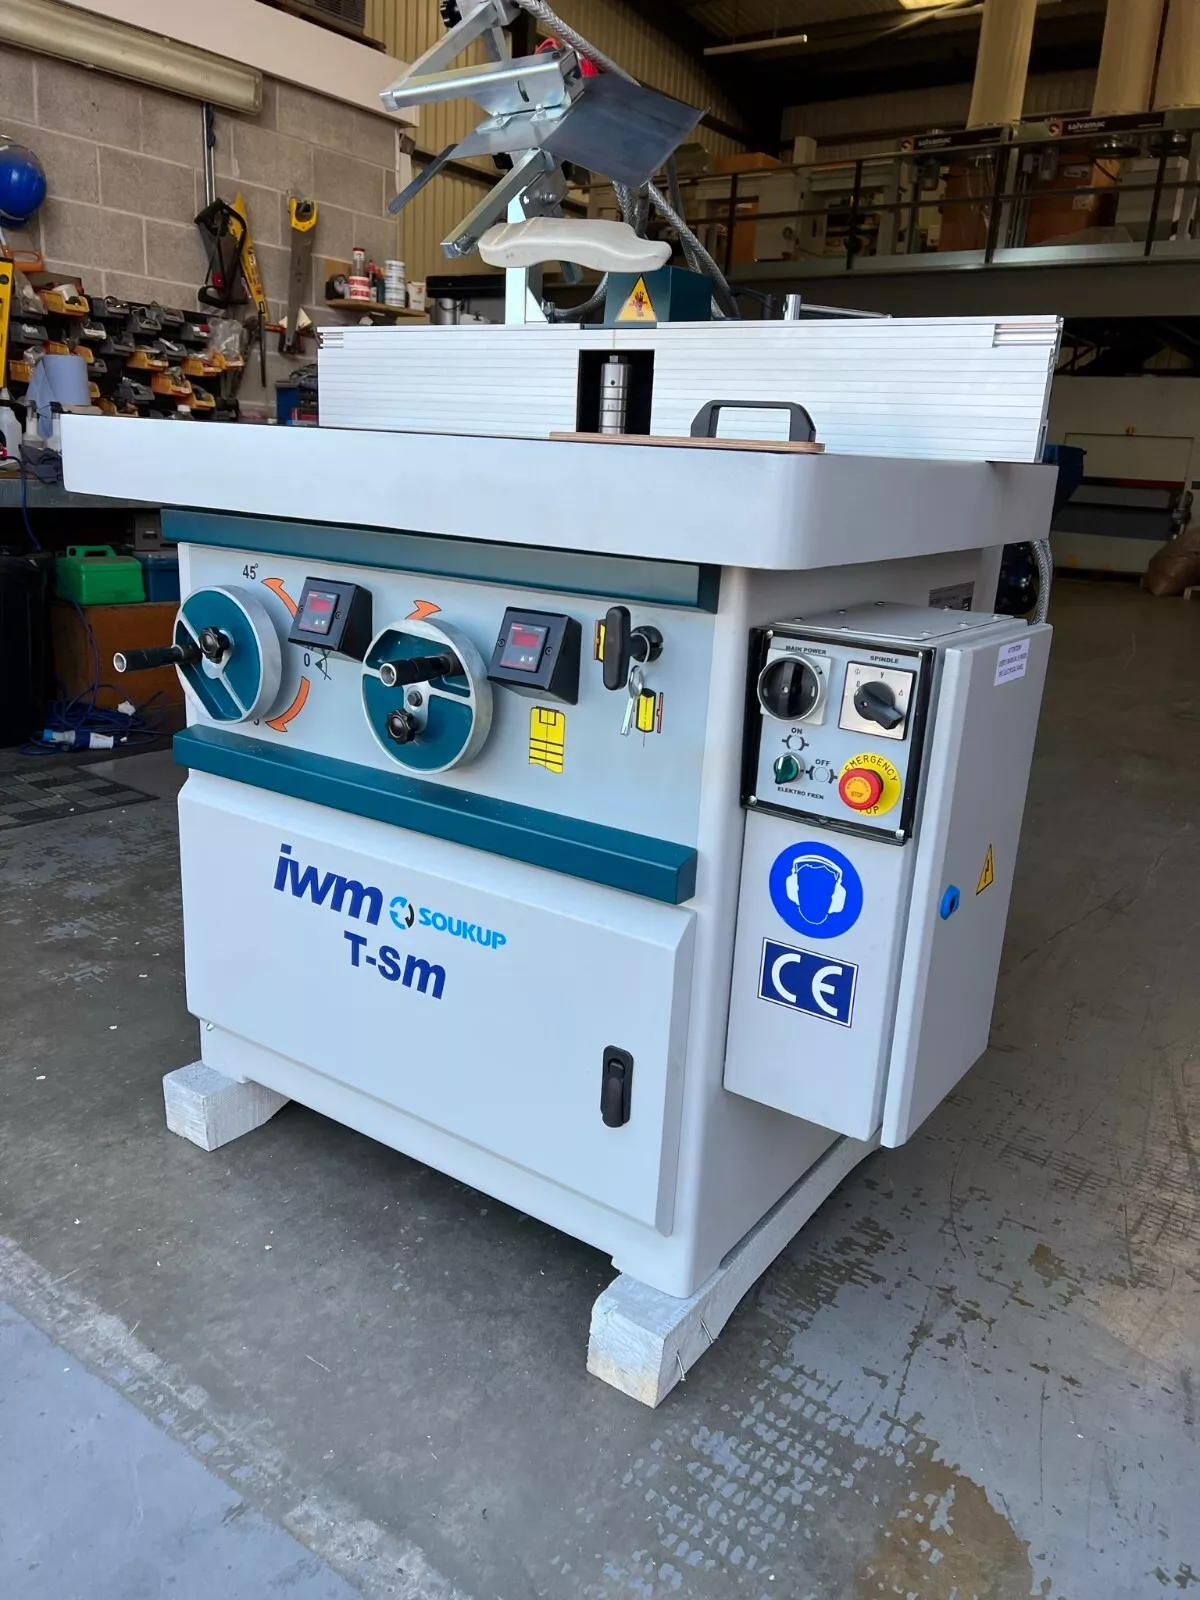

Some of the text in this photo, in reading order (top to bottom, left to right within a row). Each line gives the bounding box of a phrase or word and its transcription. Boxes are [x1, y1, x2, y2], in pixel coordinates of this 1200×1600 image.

[785, 645, 827, 655] MAIN POWER
[870, 655, 899, 664] SPINDLE
[791, 727, 803, 735] ON
[815, 758, 831, 767] OFF
[844, 754, 898, 782] EMERGENCY
[777, 786, 824, 800] ELEKTRO FREN
[273, 842, 507, 950] iwm SOUKUP
[771, 952, 844, 1017] CE
